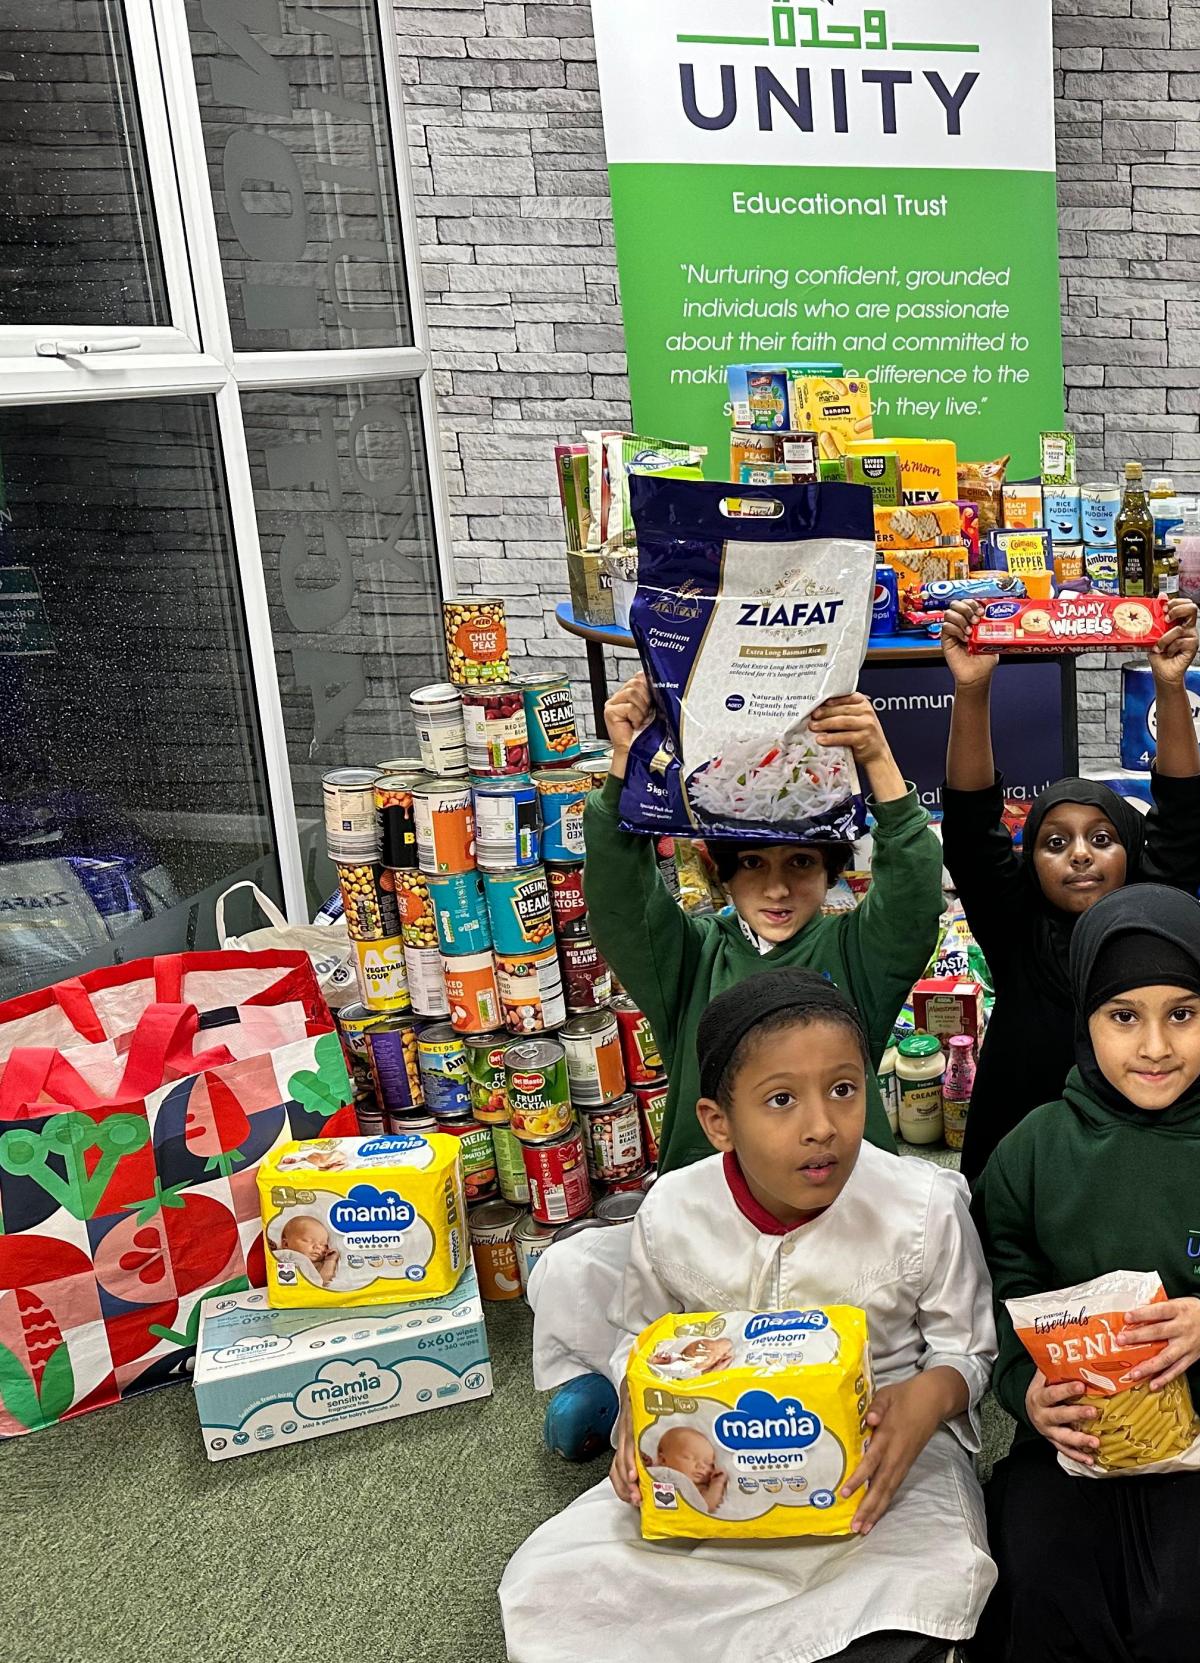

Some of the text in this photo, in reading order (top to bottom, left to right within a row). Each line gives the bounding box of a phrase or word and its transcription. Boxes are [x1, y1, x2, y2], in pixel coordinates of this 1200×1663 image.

[678, 63, 980, 135] UNITY
[732, 191, 948, 218] Educational Trust
[795, 264, 902, 288] confident,
[905, 266, 1011, 290] grounded
[682, 298, 1010, 324] individuals who are passionate
[665, 330, 1030, 353] about their faith and committed to
[865, 363, 969, 385] difference
[972, 367, 993, 384] to
[997, 365, 1030, 384] the
[824, 407, 850, 415] banana
[896, 397, 942, 419] they
[911, 462, 941, 476] Morn
[1010, 556, 1043, 568] PEPPER
[735, 600, 844, 627] ZIAFAT
[1056, 602, 1104, 618] JAMMY
[1050, 616, 1112, 636] WHEELS
[469, 633, 496, 641] CHICK
[649, 628, 690, 642] Premium
[473, 642, 496, 650] PEAS
[648, 638, 685, 652] Quality
[746, 647, 763, 655] Extra
[765, 649, 781, 657] Long
[782, 648, 807, 656] Basmati
[544, 691, 570, 706] HEINZ
[750, 702, 782, 710] Elegantly
[541, 705, 574, 723] BEANZ
[748, 709, 786, 717] Exquisitely
[521, 880, 548, 896] HEINZ
[518, 895, 550, 915] BEANZ
[572, 955, 598, 965] BEANS
[934, 958, 968, 972] PASTA
[513, 1077, 543, 1086] Del Monte
[516, 1094, 542, 1102] FRUIT
[911, 1089, 940, 1100] CREAMY
[511, 1100, 552, 1109] COCKTAIL
[462, 1130, 491, 1146] HEINZ
[618, 1130, 636, 1139] MIXED
[619, 1135, 638, 1144] BEANS
[363, 1137, 424, 1152] mamia
[336, 1198, 409, 1222] mamia
[347, 1235, 400, 1244] newborn
[751, 1312, 824, 1333] mamia
[1034, 1306, 1090, 1335] Essentials
[418, 1328, 477, 1350] 6x60 wipes
[751, 1333, 806, 1346] newborn
[227, 1340, 277, 1355] mamia
[311, 1372, 381, 1403] mamia
[327, 1393, 368, 1408] sensitive
[653, 1392, 663, 1405] 1
[328, 1403, 356, 1413] fragrance
[322, 1418, 339, 1426] gentle
[367, 1406, 388, 1414] delicate
[722, 1406, 814, 1439] mamia
[738, 1453, 803, 1464] newborn
